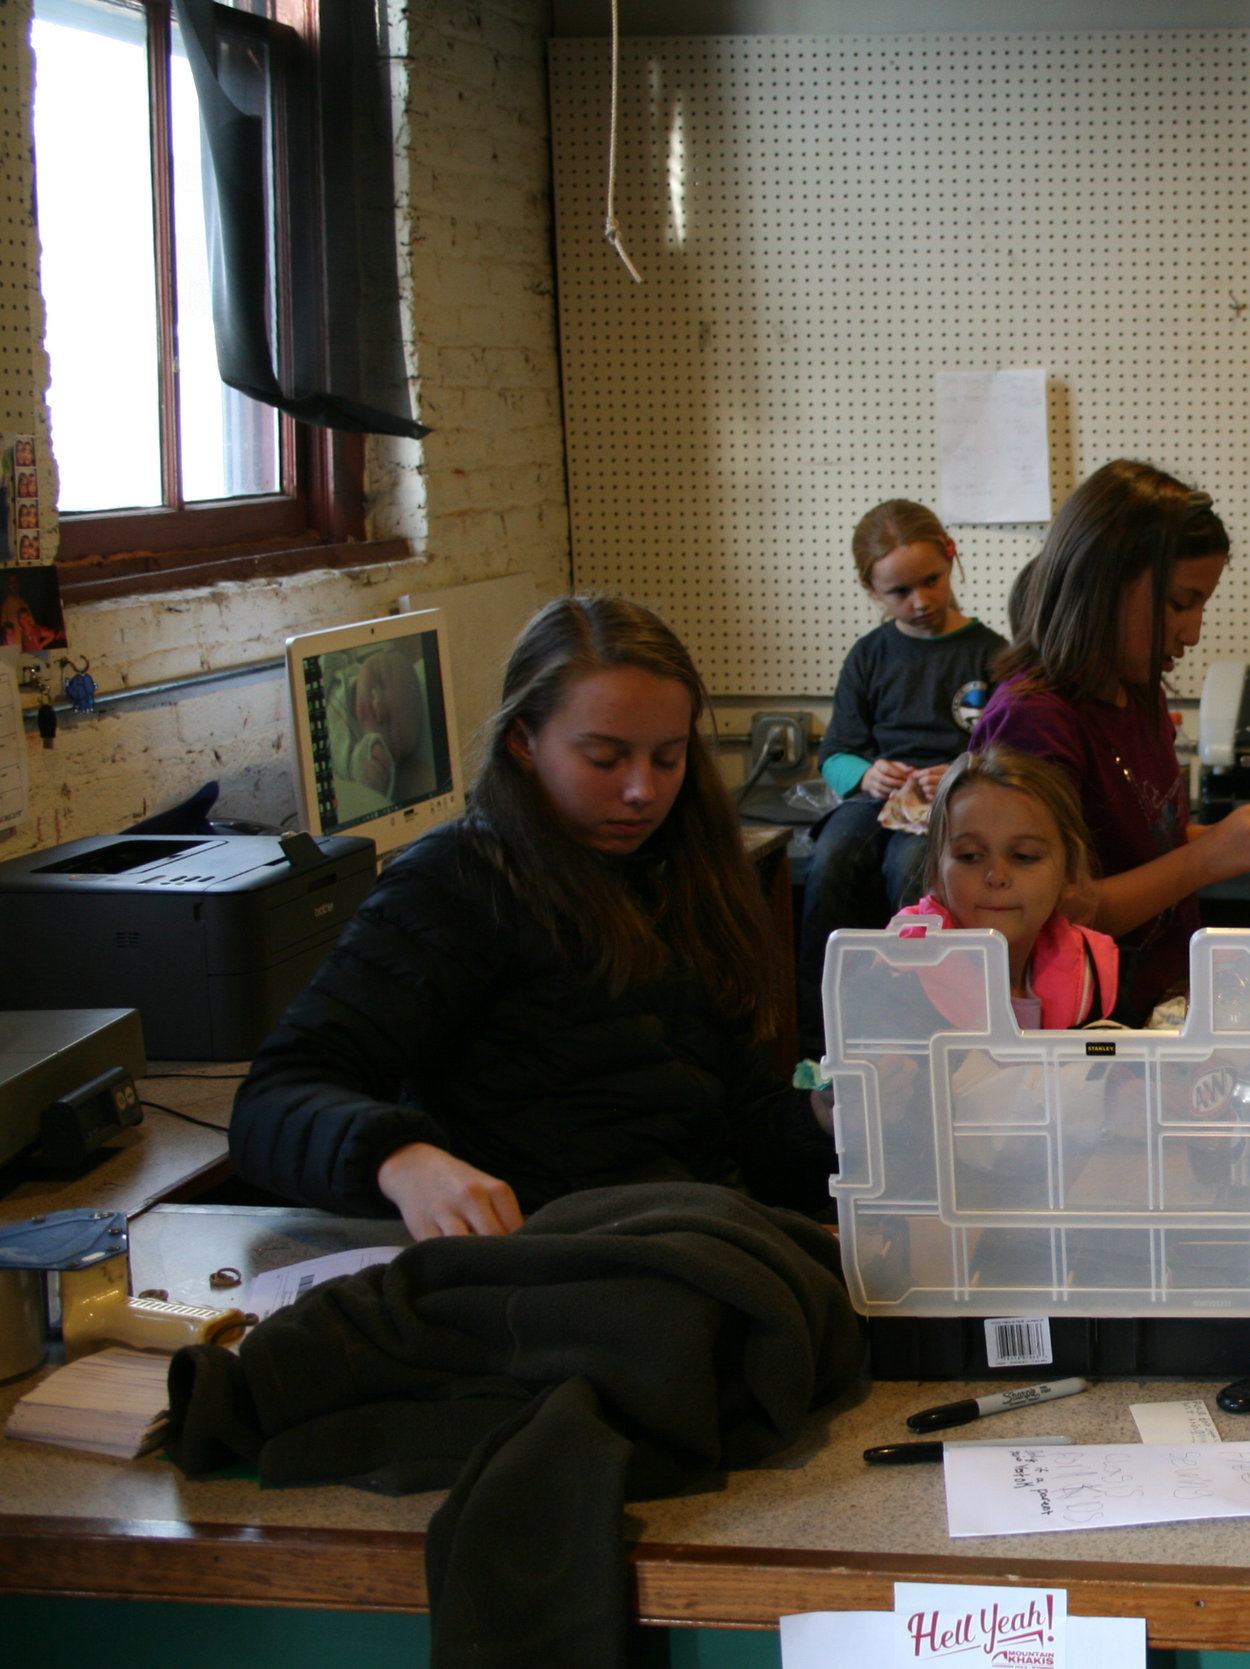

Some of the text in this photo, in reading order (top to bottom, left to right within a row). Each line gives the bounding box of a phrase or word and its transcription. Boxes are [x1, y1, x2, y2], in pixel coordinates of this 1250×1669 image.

[1029, 1488, 1054, 1516] parent
[907, 1594, 1055, 1657] Hell Yeah!
[1008, 1656, 1055, 1665] KHAKIS
